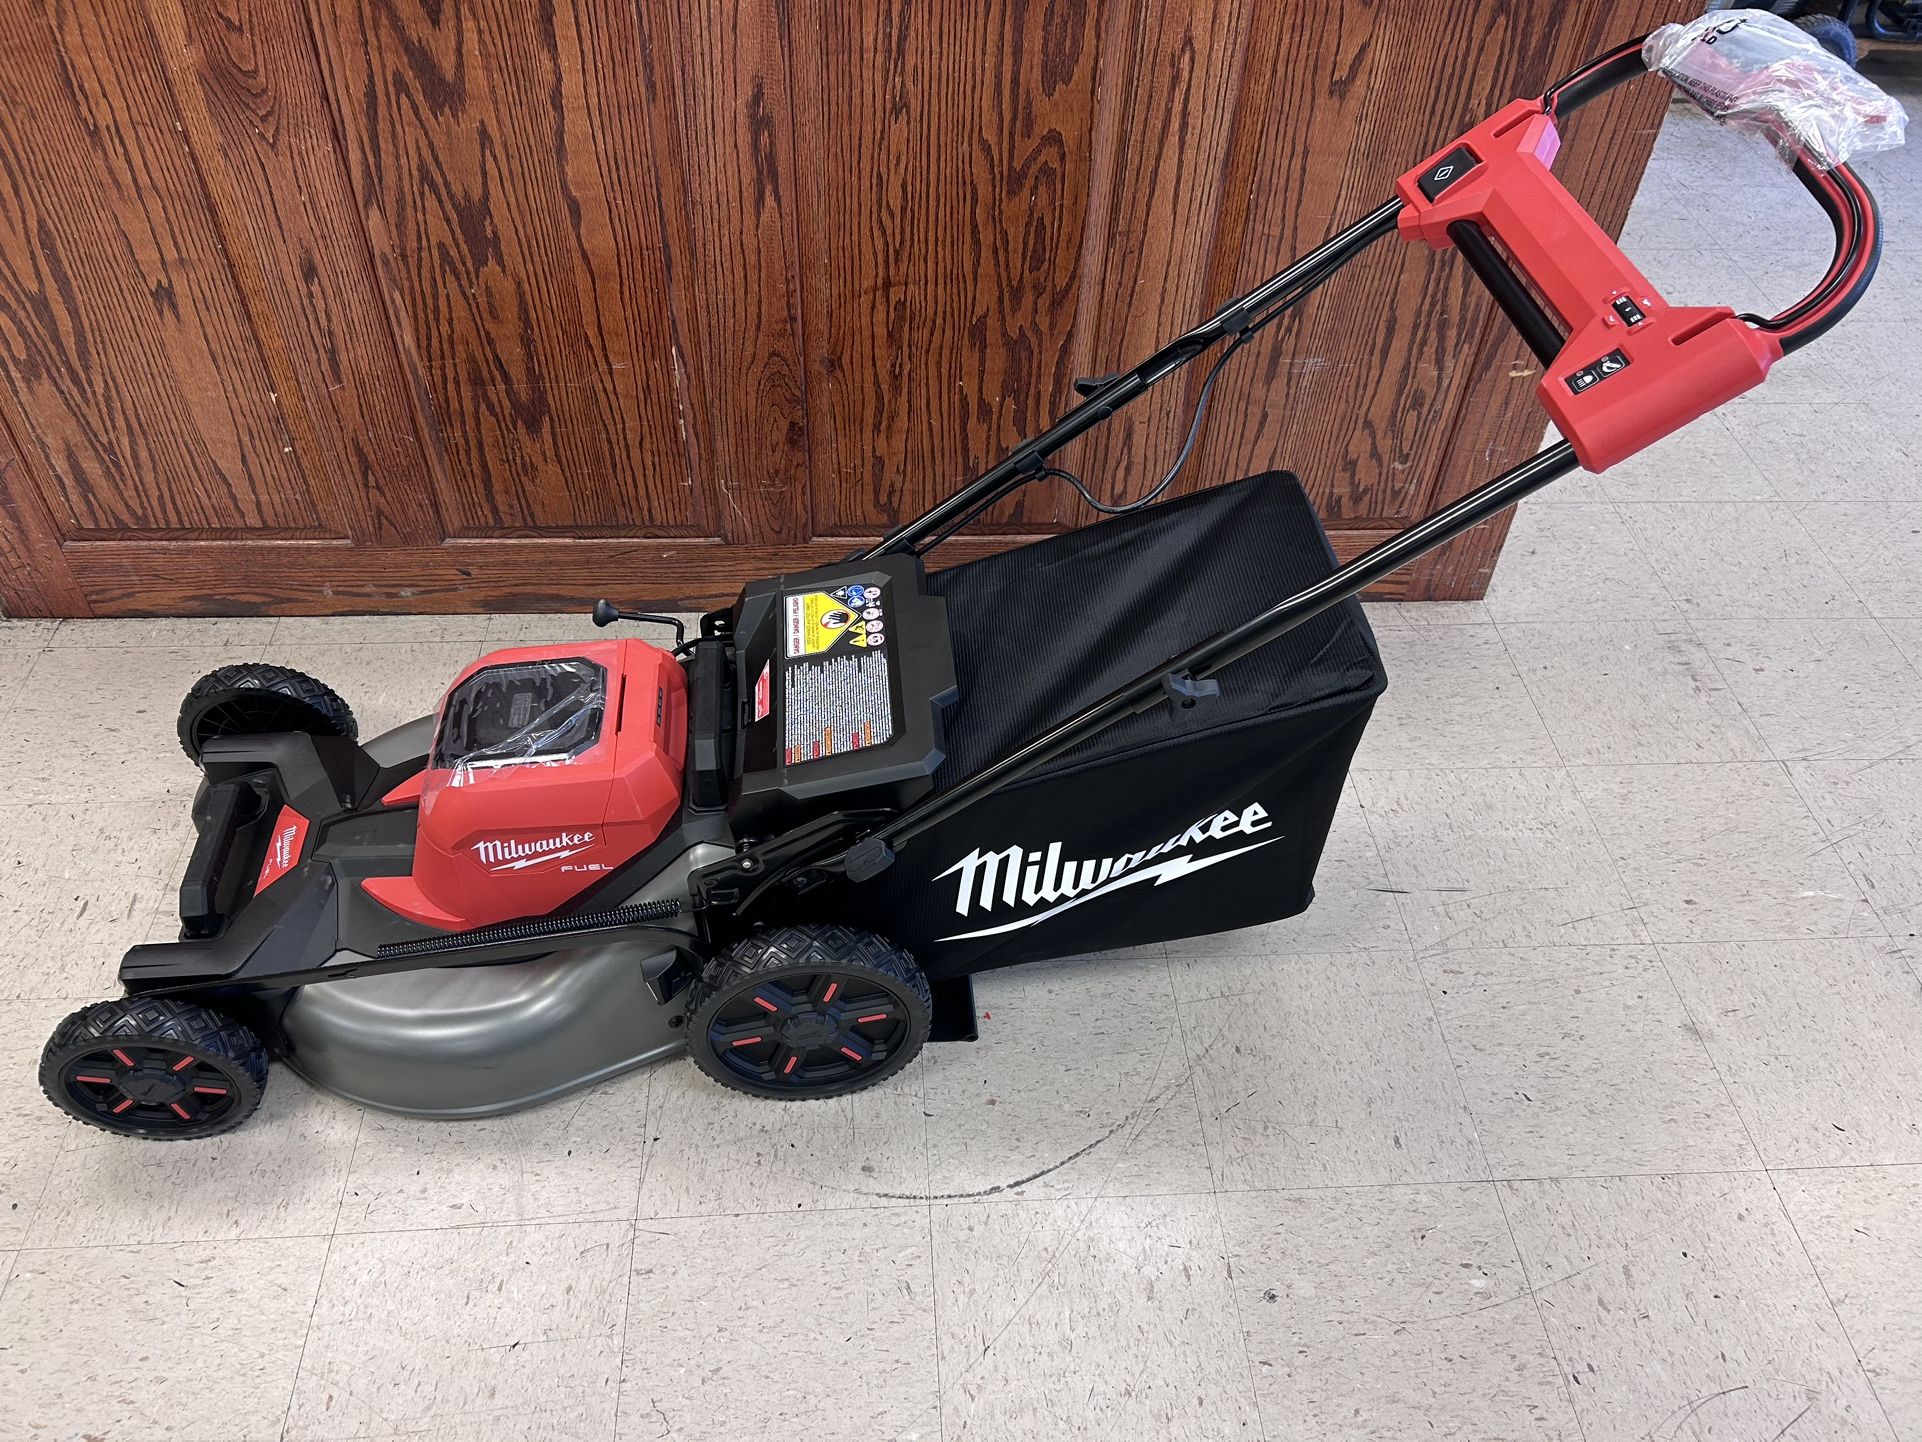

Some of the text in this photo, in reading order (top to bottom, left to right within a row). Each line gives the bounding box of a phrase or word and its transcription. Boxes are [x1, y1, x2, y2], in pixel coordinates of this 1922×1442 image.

[471, 831, 596, 864] Milwaukee
[932, 802, 1272, 917] Milwaukee
[561, 863, 614, 872] FUEL
